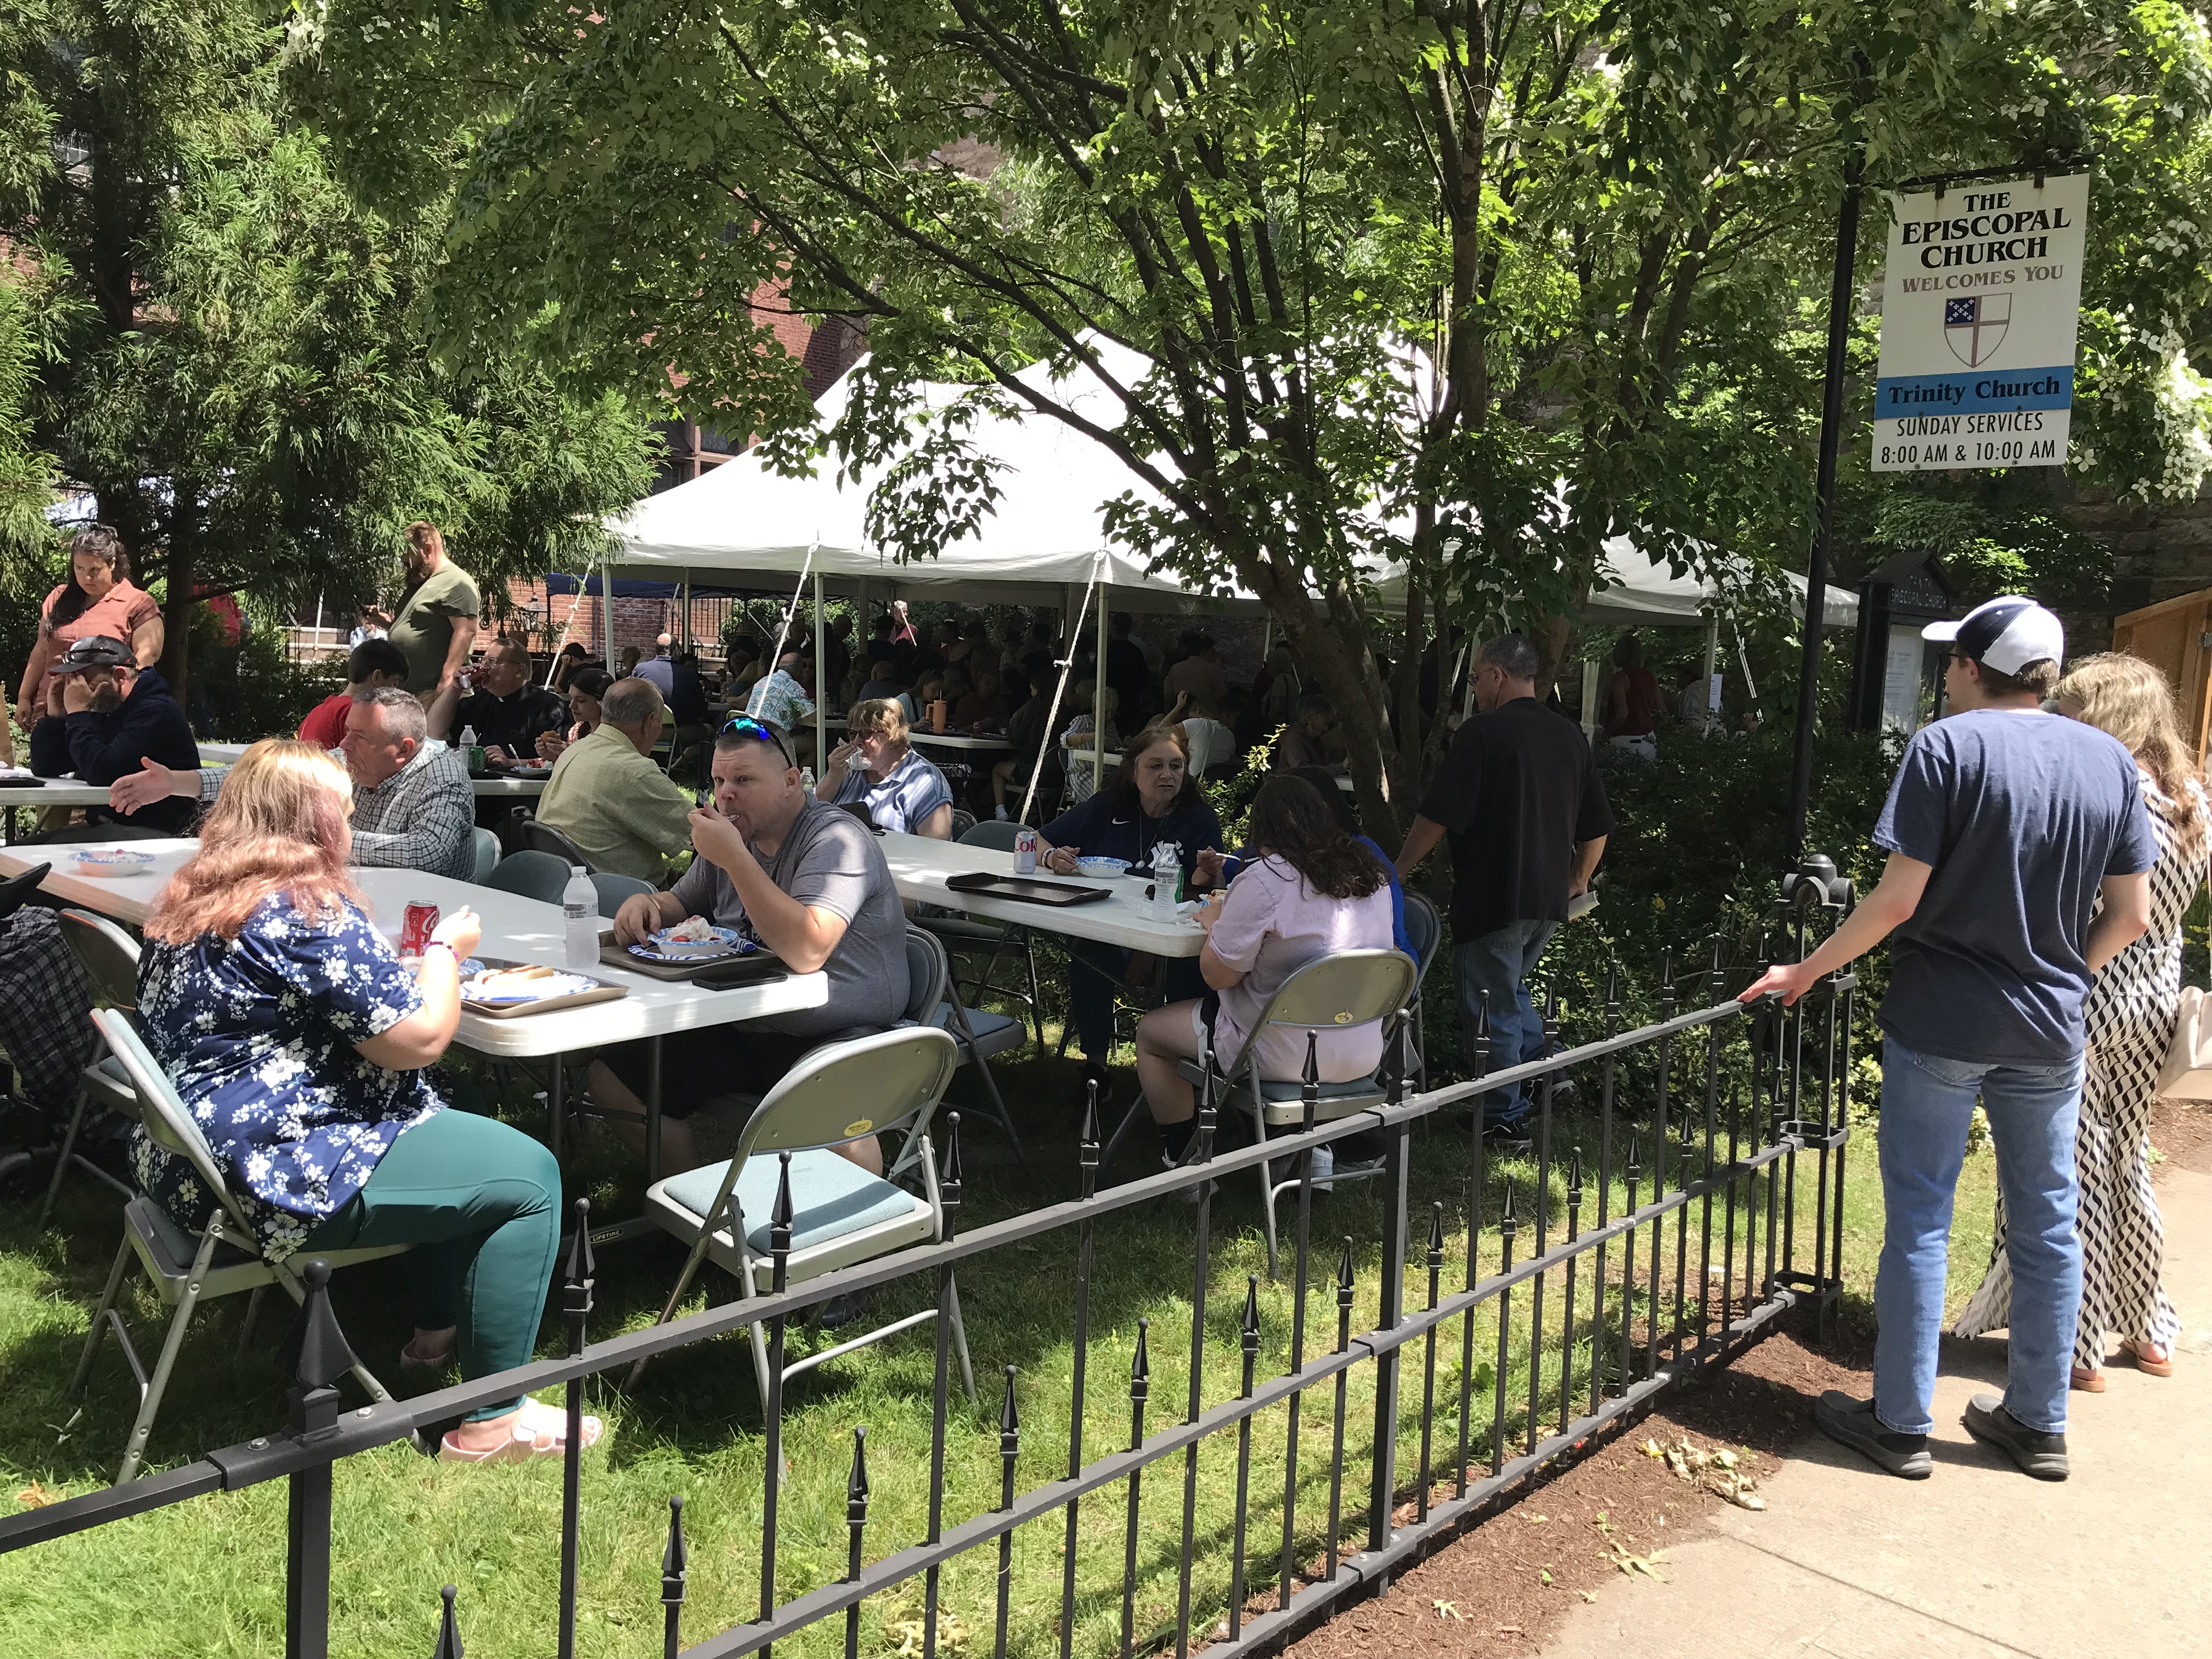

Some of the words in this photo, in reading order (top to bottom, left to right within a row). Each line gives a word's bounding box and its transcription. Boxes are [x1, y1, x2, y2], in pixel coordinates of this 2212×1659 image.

[1963, 191, 2011, 212] THE
[1901, 207, 2072, 246] EPISCOPAL
[1921, 236, 2048, 269] CHURCH
[1903, 270, 2016, 294] WELCOMES
[2024, 265, 2064, 282] YOU
[1889, 383, 1966, 406] Trinity
[1975, 376, 2060, 399] Church
[1897, 415, 1961, 437] SUNDAY
[1967, 412, 2043, 433] SERVICES
[1881, 445, 1917, 465] 8:00
[1923, 444, 1948, 463] AM
[1955, 444, 1967, 461] &
[1976, 441, 2023, 461] 10:00
[2029, 439, 2056, 459] AM
[1891, 588, 1922, 606] EPISCOPAL
[1925, 593, 1946, 609] CHURCH
[1014, 836, 1037, 852] Cok
[592, 1230, 620, 1242] LIFETIME
